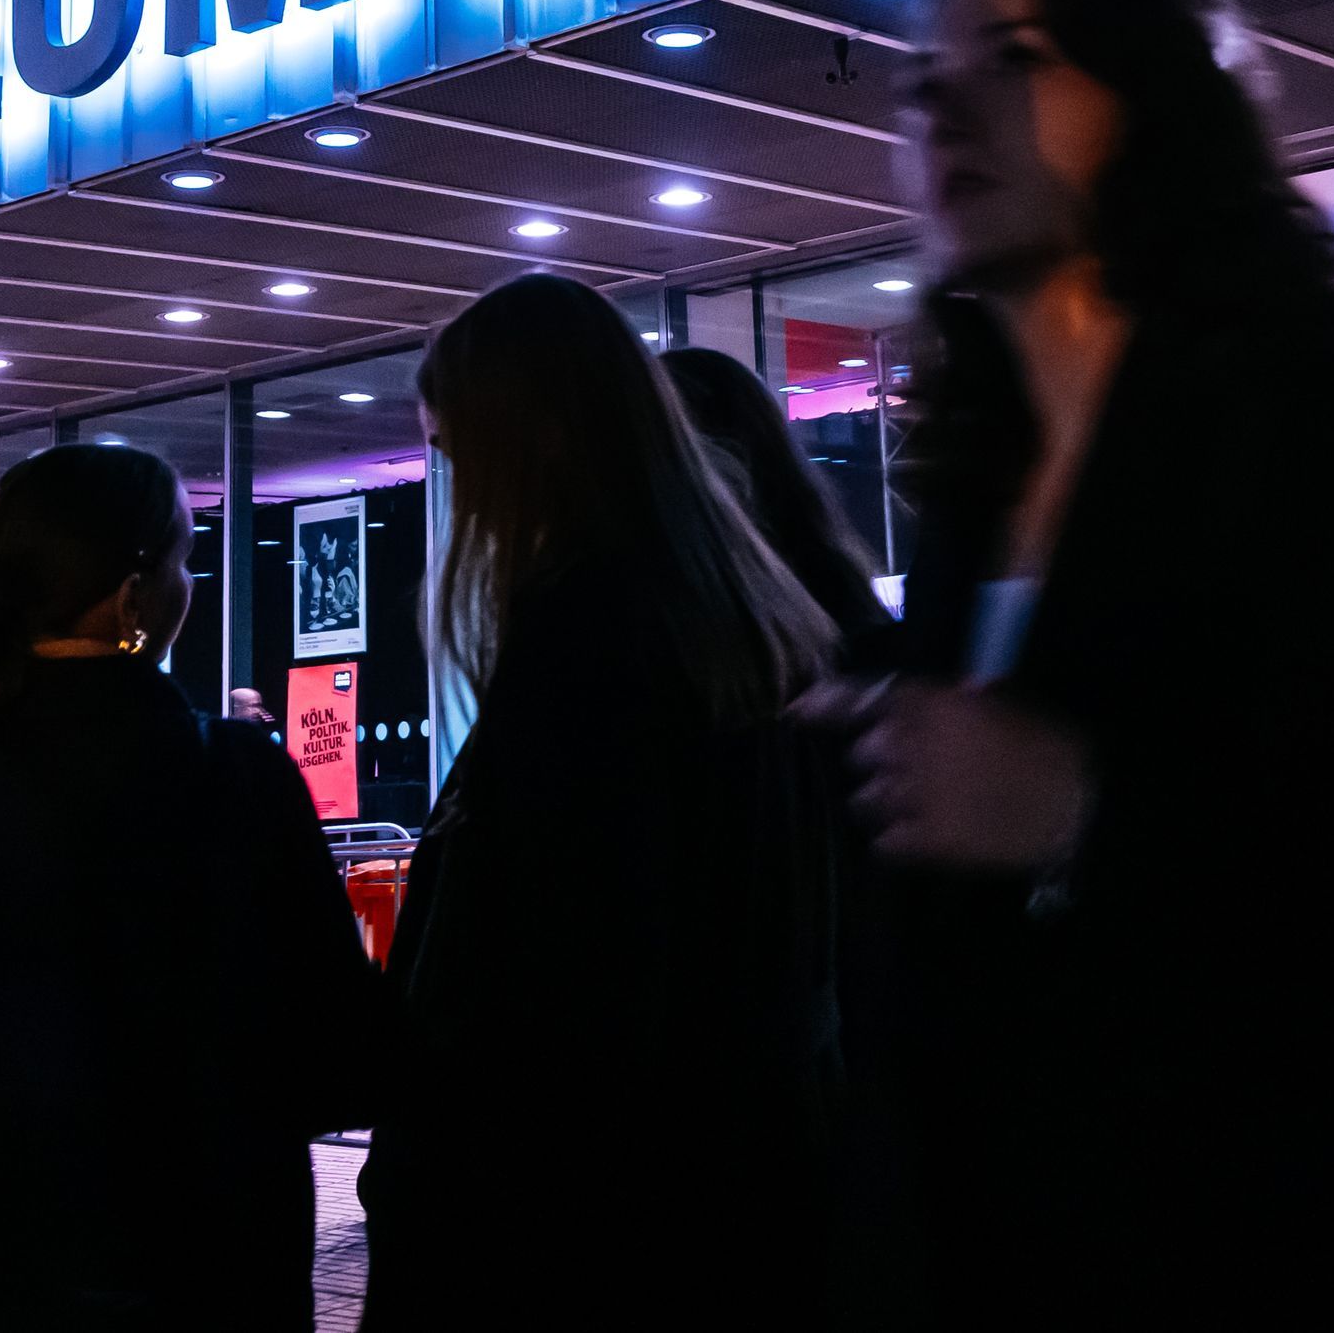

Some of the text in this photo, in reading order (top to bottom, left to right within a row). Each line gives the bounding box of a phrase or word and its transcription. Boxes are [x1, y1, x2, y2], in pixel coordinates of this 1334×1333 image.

[301, 707, 337, 728] KÖLN.
[309, 721, 351, 740] POLITIK.
[303, 736, 346, 755] KULTUR.
[299, 750, 343, 768] USGEHEN.
